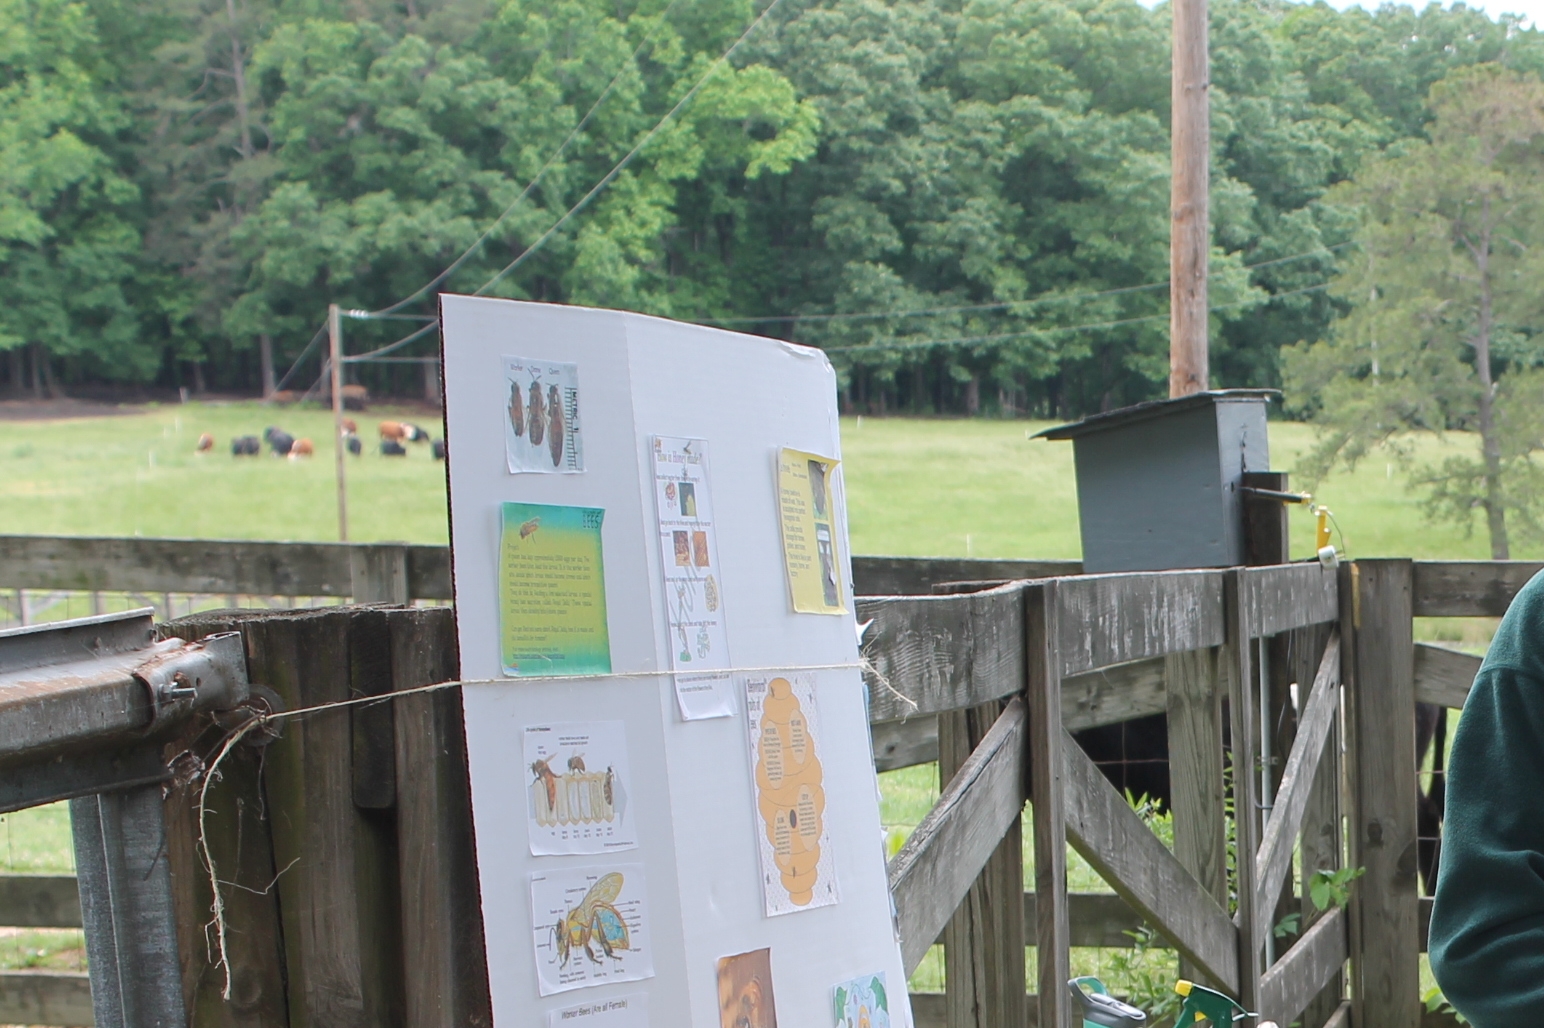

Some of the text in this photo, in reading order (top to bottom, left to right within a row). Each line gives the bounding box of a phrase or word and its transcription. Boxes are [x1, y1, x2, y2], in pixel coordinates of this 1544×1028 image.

[562, 1010, 578, 1020] Worker
[578, 1007, 590, 1016] Bees
[592, 1004, 601, 1016] (Are
[608, 998, 628, 1010] Female)
